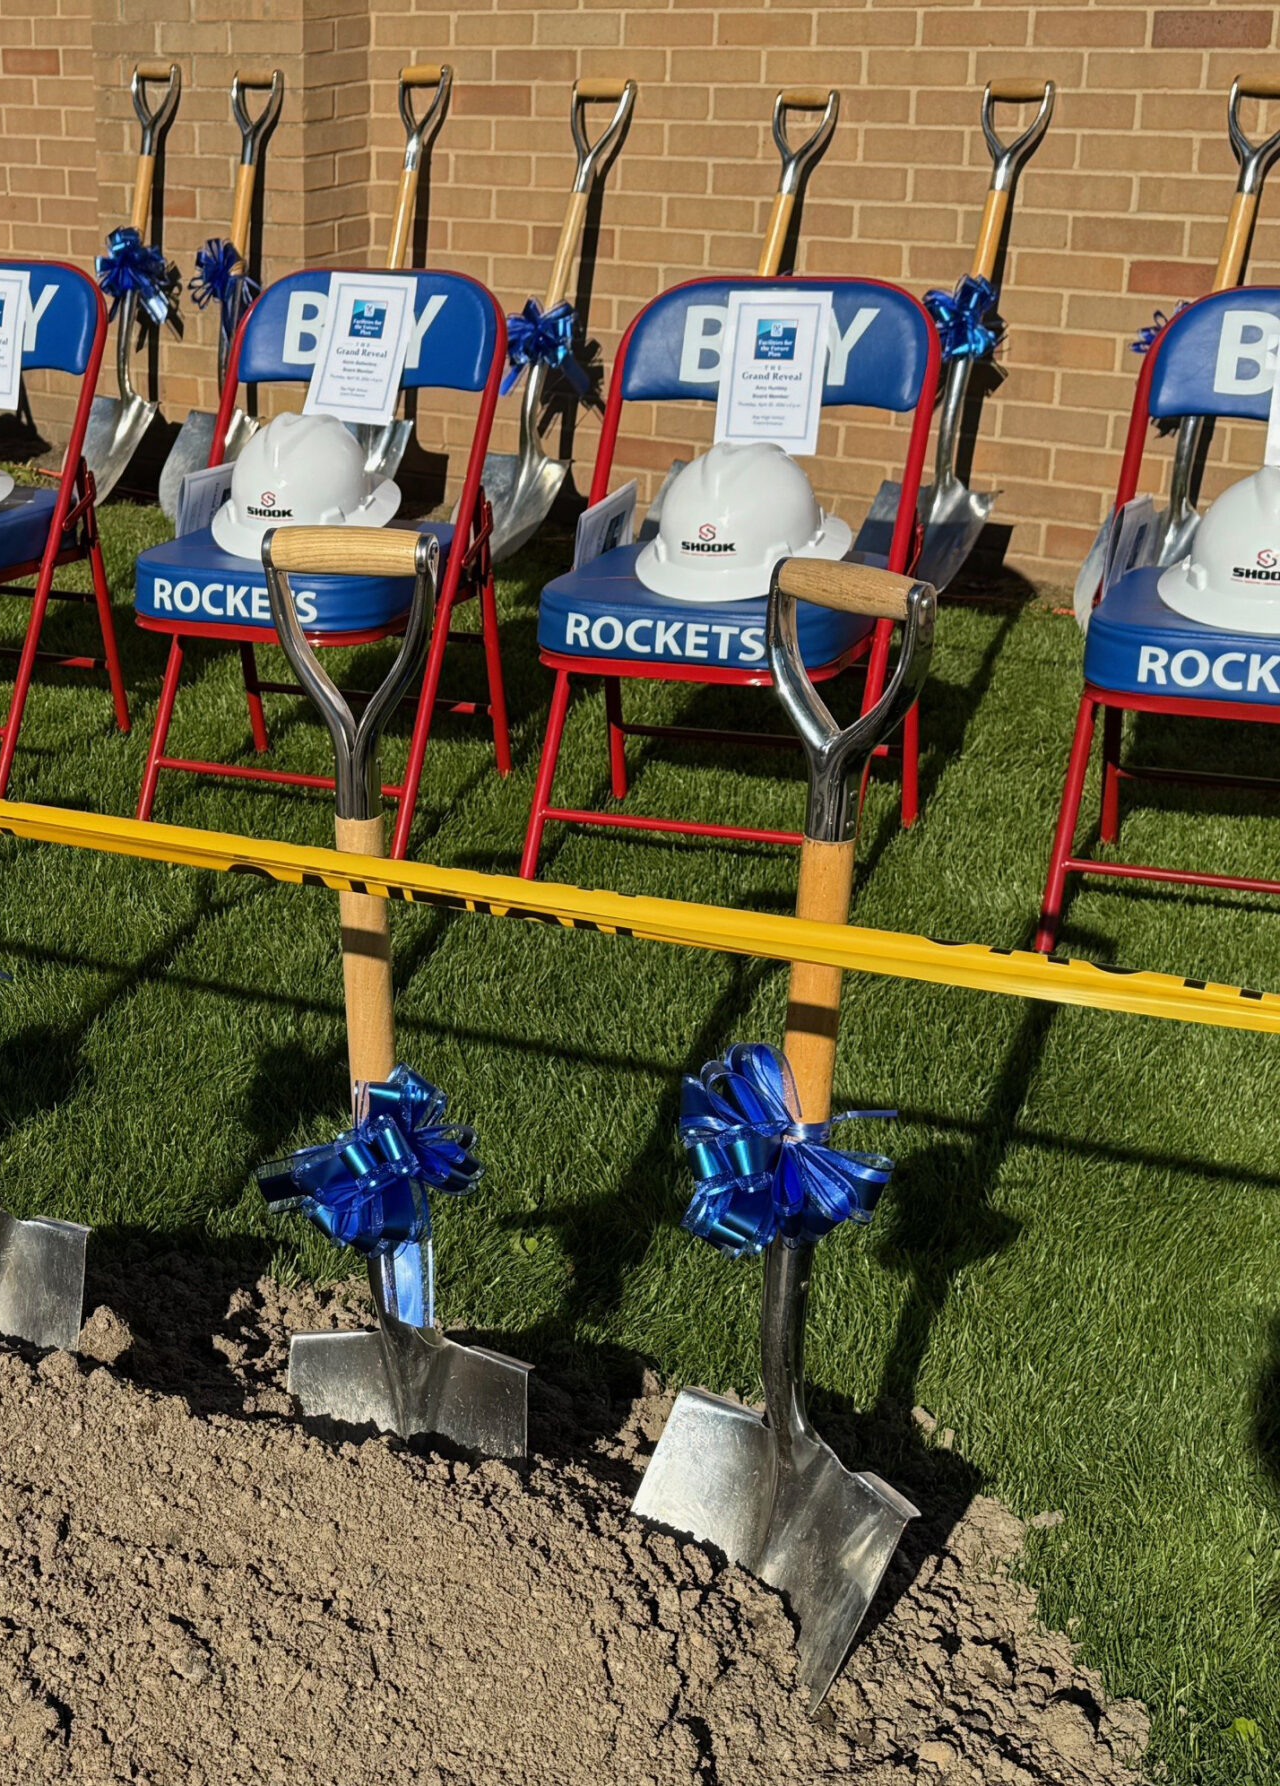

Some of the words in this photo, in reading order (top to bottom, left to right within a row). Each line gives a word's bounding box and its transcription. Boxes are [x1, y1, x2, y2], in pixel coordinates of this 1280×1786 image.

[281, 290, 448, 368] BY
[336, 348, 360, 356] Grand
[361, 349, 388, 358] Reveal
[679, 304, 881, 386] BY
[742, 371, 770, 381] Grand
[772, 372, 802, 382] Reveal
[247, 506, 293, 518] SHOOK
[681, 541, 737, 552] SHOOK
[154, 578, 318, 624] ROCKES
[565, 612, 766, 662] ROCKETS
